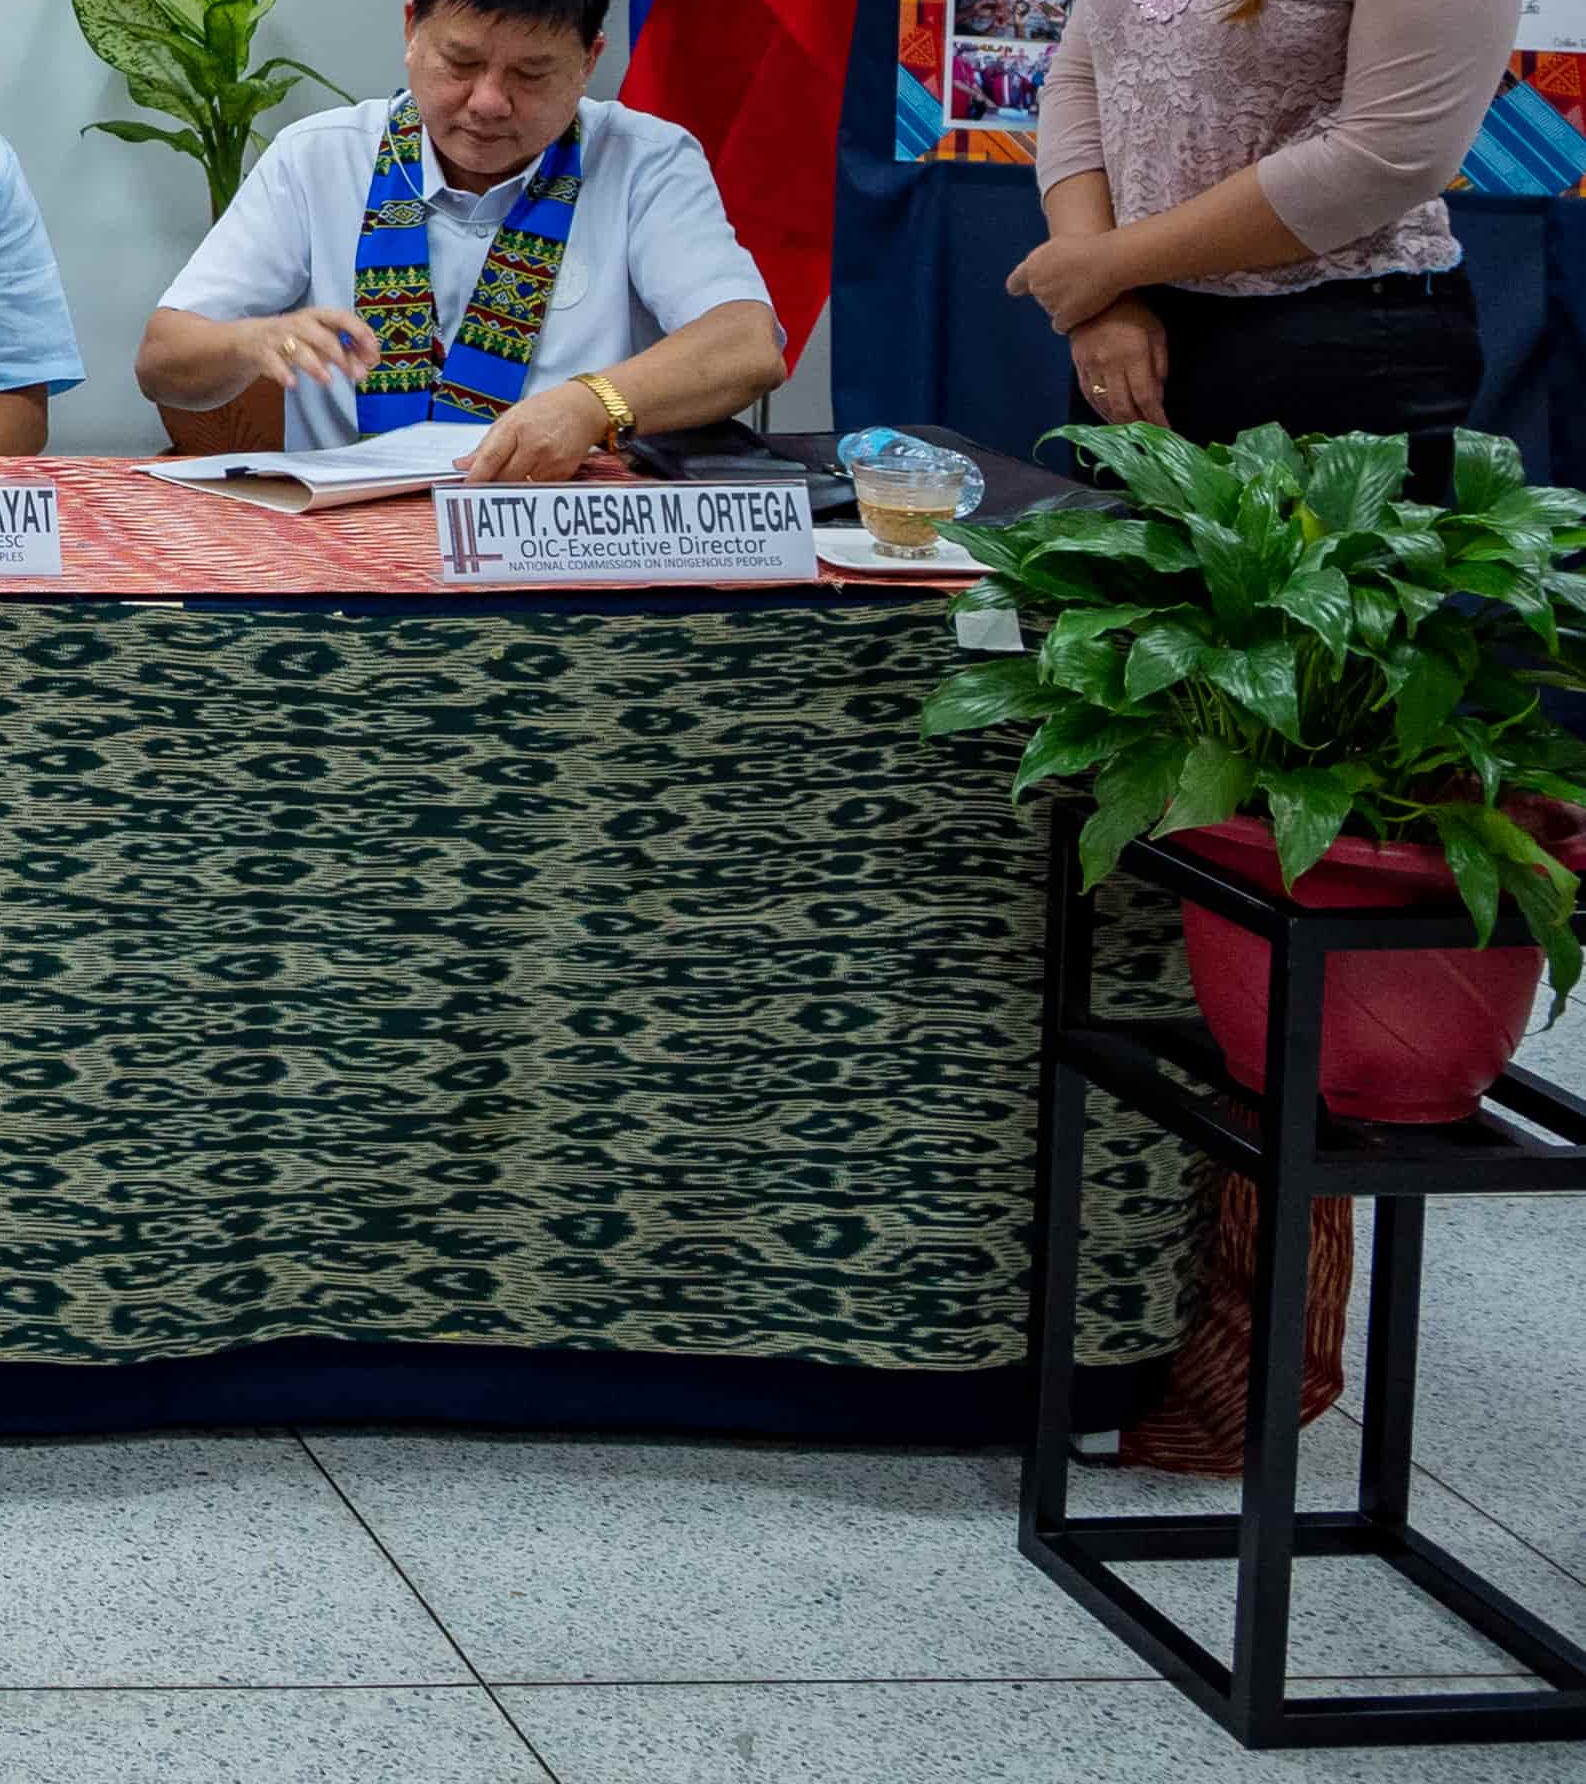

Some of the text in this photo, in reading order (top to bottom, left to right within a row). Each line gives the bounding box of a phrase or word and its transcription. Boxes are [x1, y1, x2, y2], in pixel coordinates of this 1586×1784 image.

[477, 491, 802, 538] ATTY. CAESAR M. ORTEGA
[519, 534, 767, 559] OIC-Executive Director
[508, 555, 783, 572] NATIONAL COMMISSION ON INDIGENOUS PEOPLES
